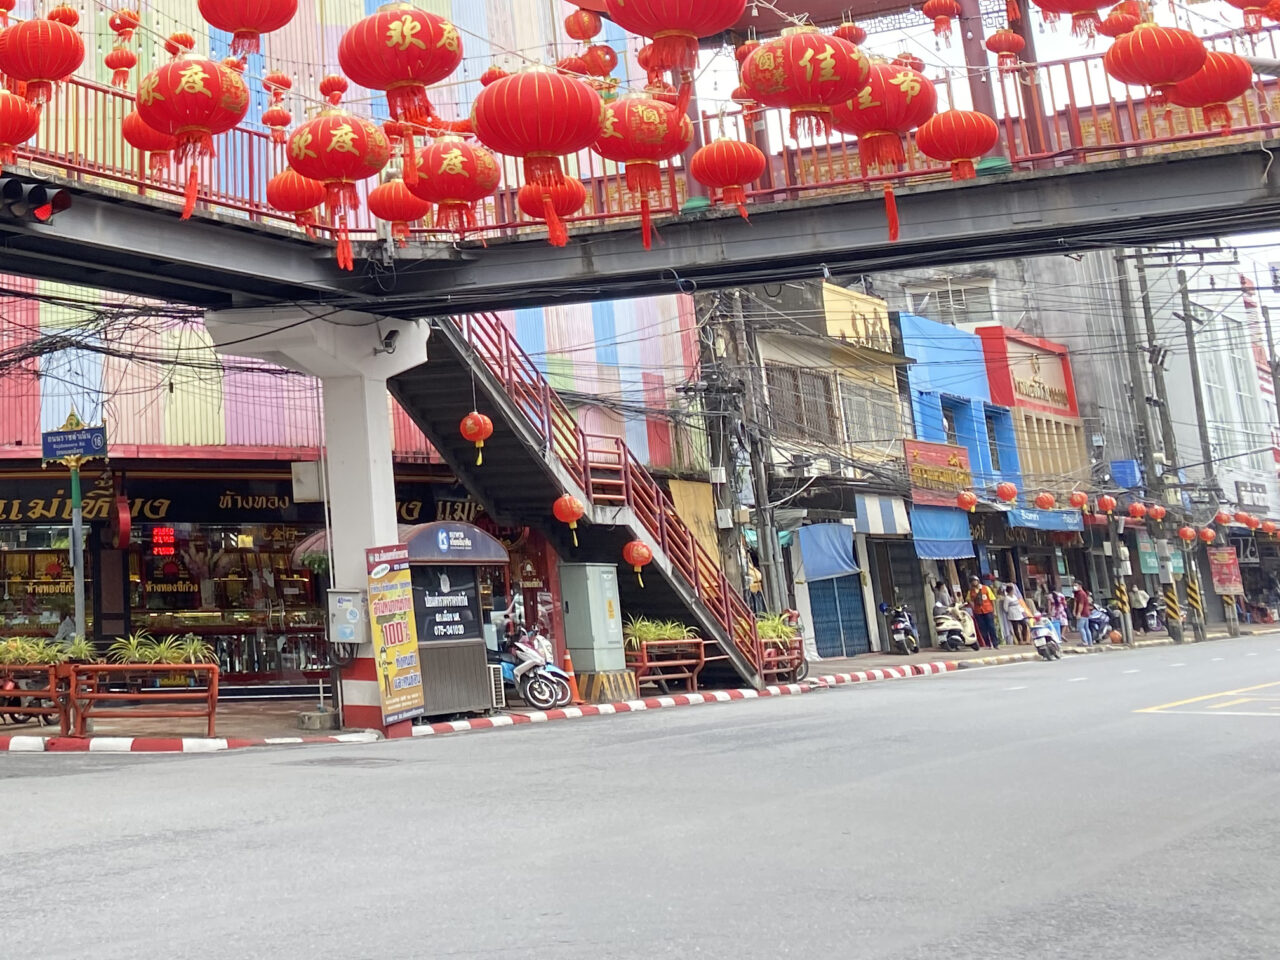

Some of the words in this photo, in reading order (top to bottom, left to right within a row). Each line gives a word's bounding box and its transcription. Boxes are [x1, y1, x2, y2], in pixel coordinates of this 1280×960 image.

[219, 490, 289, 509] ห้างทอง
[384, 622, 411, 646] 100%
